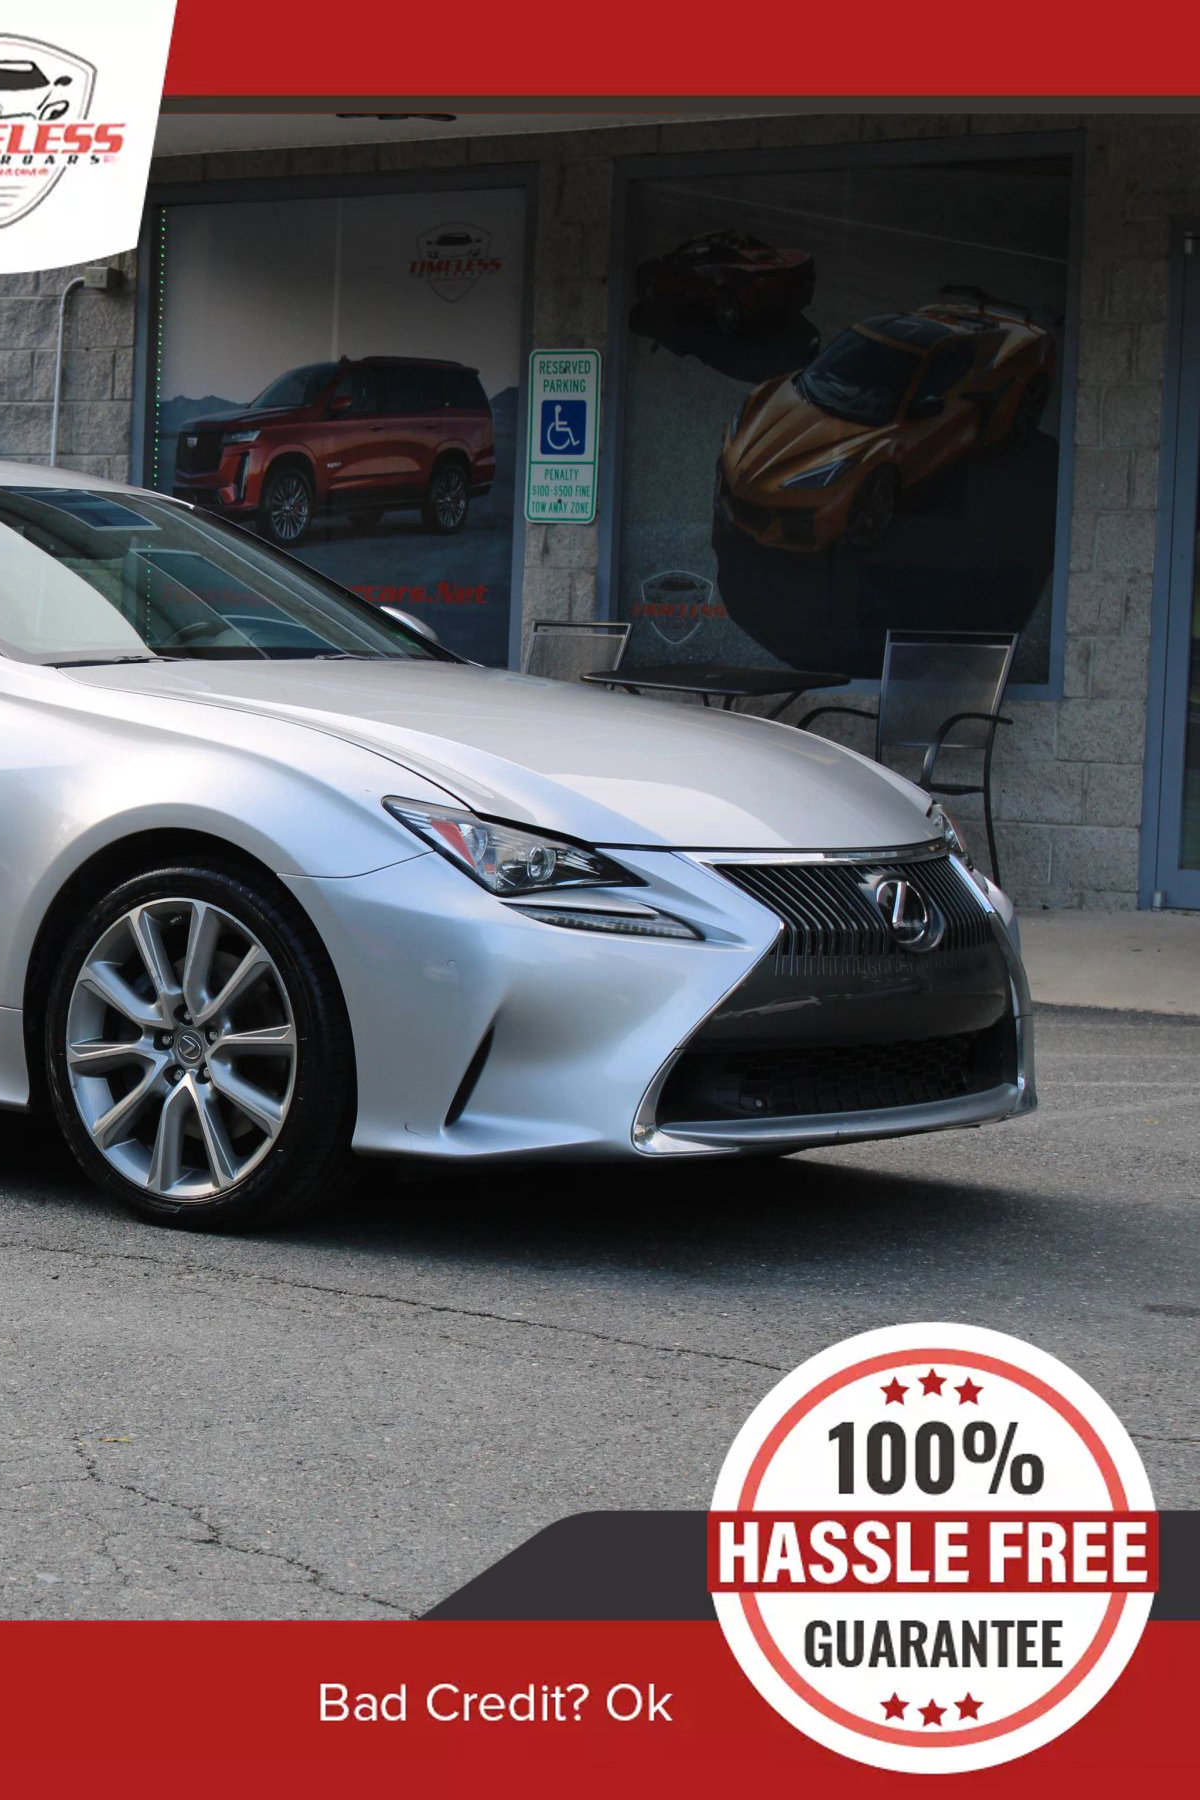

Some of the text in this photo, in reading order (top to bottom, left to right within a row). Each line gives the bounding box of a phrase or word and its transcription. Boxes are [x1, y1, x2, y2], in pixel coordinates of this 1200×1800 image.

[539, 360, 591, 375] RESERVED
[543, 379, 586, 393] PARKING
[544, 468, 580, 482] PENALTY
[575, 486, 591, 498] FINE
[531, 501, 589, 514] TOW AWAY ZONE
